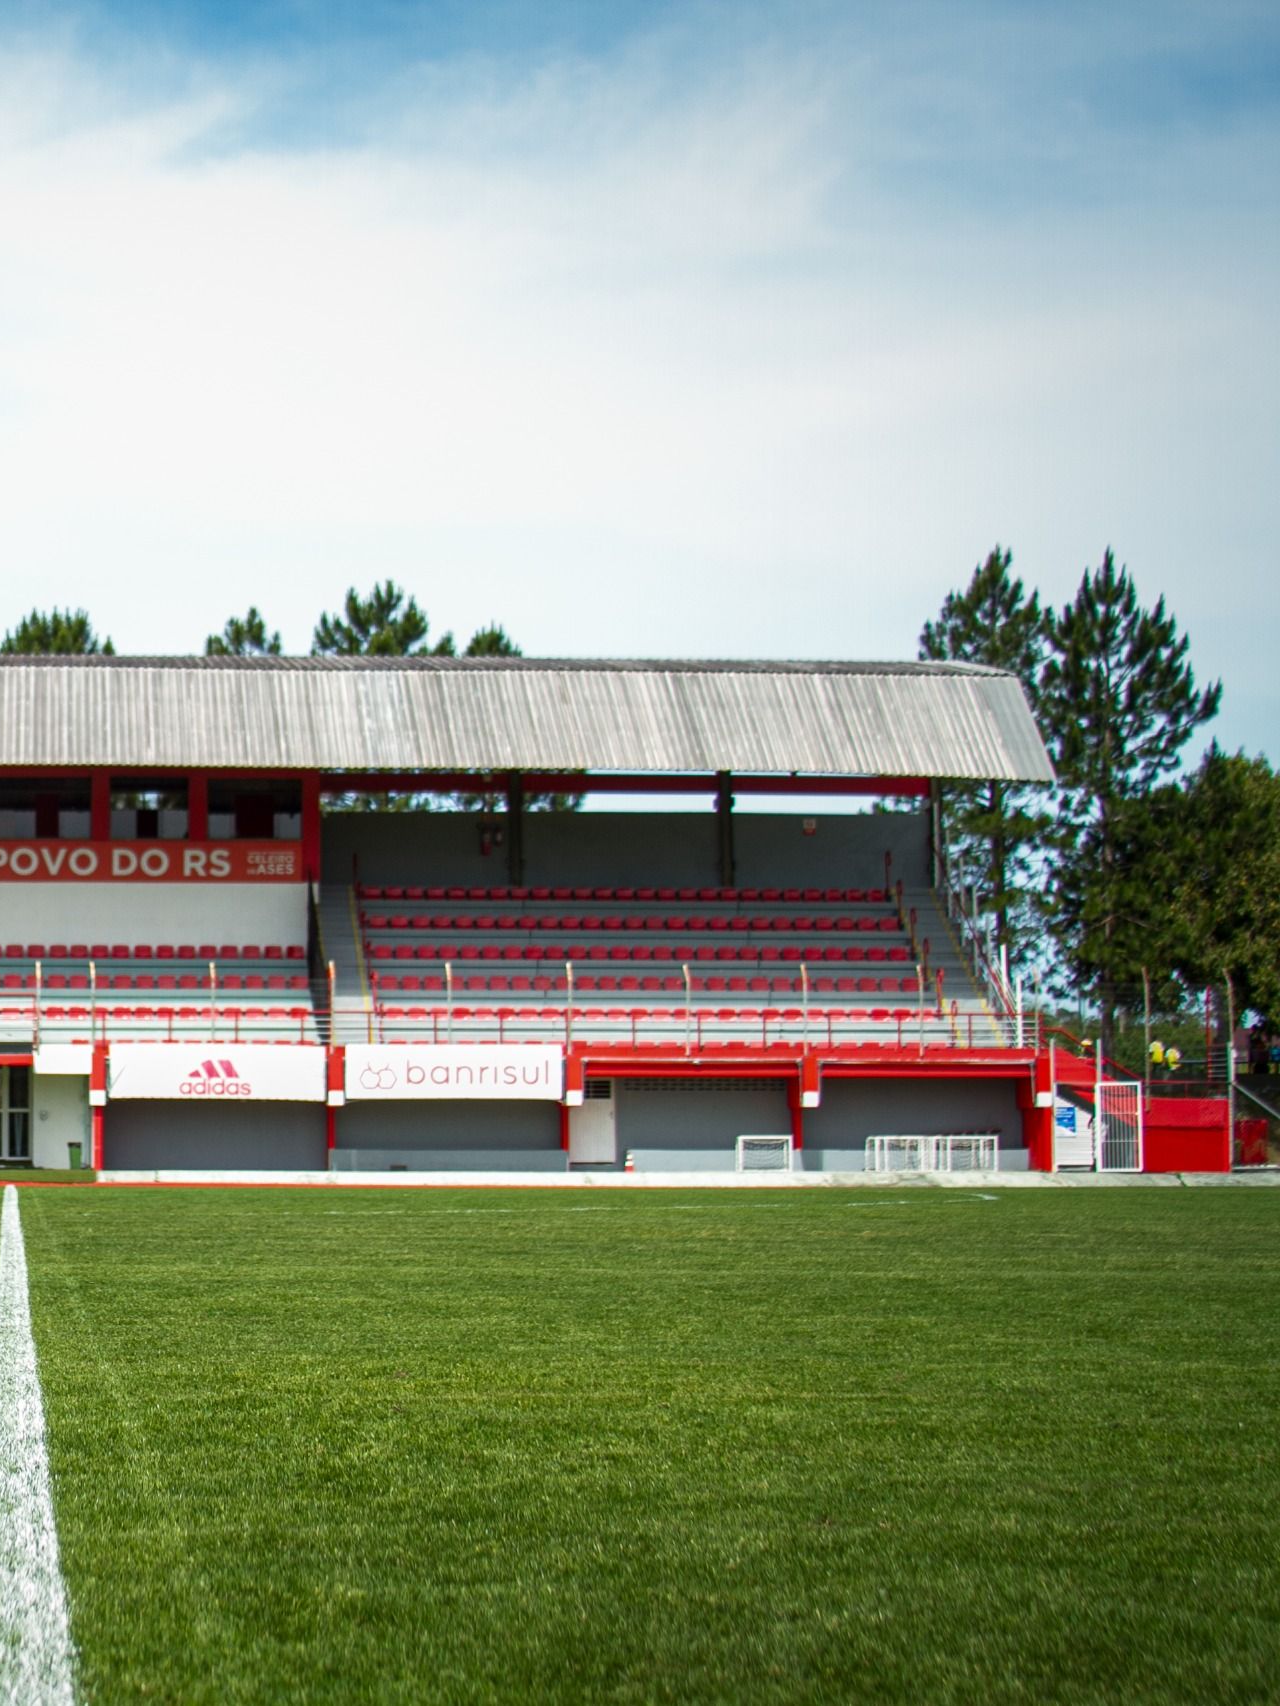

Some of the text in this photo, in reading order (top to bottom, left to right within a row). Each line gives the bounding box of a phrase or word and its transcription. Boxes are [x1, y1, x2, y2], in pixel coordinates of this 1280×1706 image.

[111, 848, 170, 877] DO
[182, 848, 232, 878] RS
[257, 863, 294, 875] ASES
[406, 1059, 549, 1085] banrisul
[179, 1079, 251, 1095] adidas
